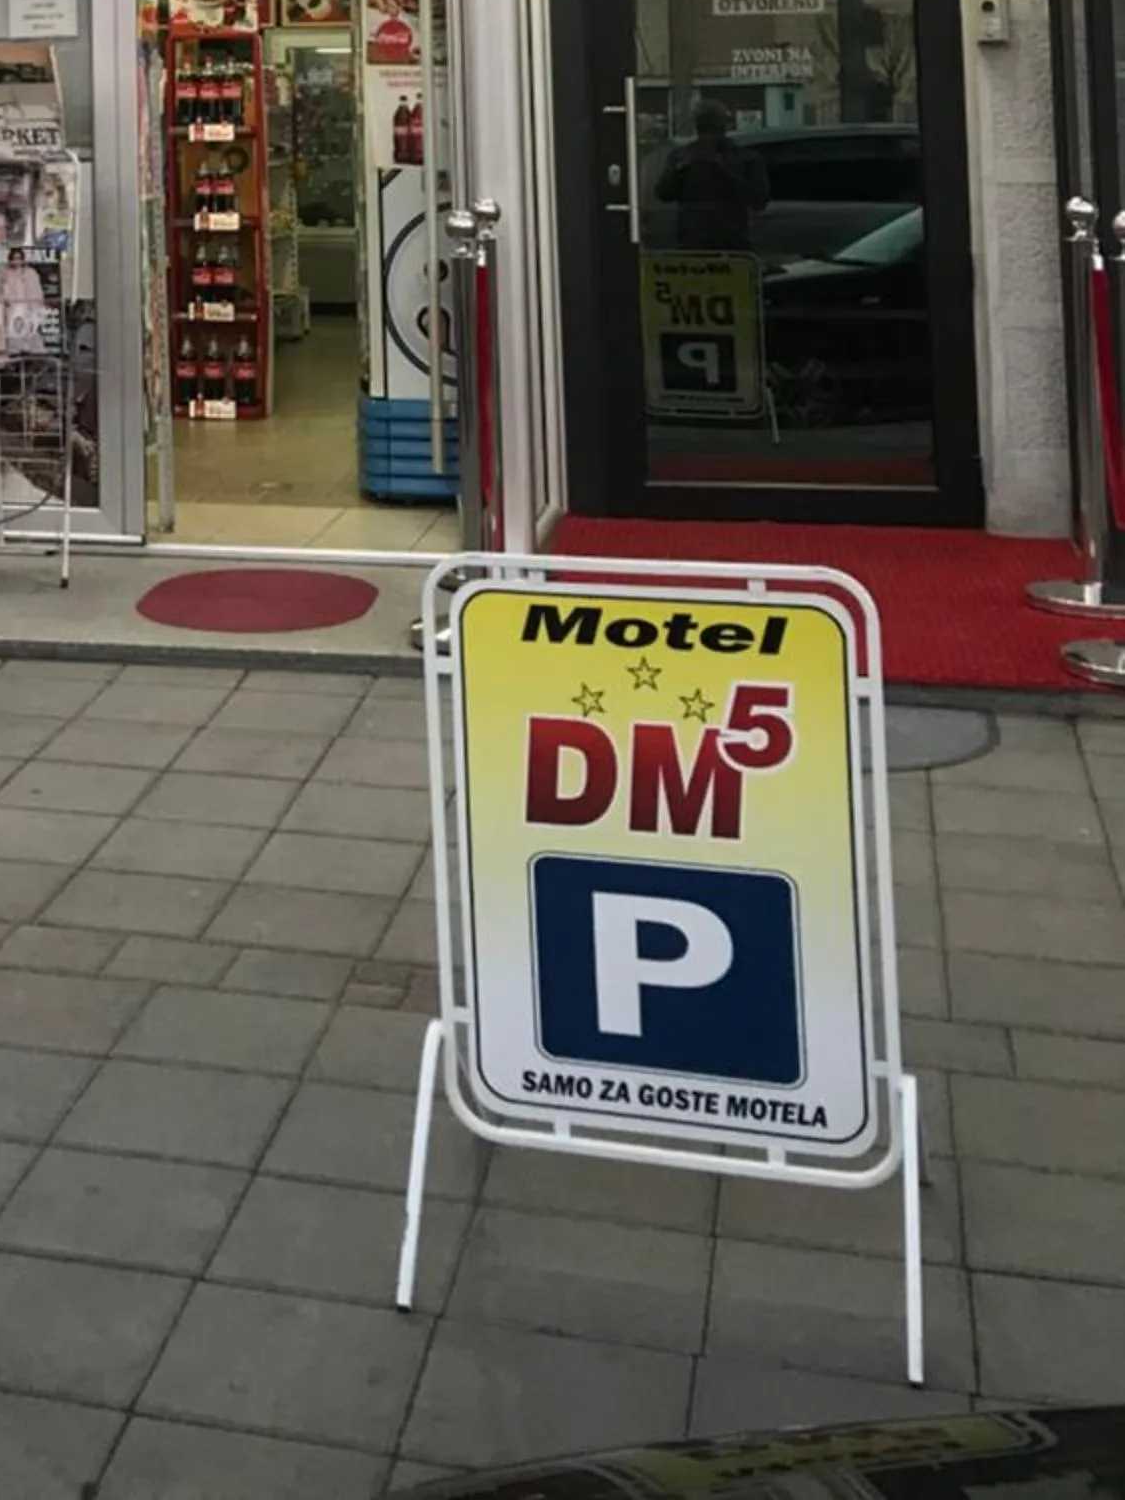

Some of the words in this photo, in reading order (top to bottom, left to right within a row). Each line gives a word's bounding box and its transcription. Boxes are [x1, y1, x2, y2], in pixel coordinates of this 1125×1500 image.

[521, 603, 790, 656] Motel
[525, 681, 795, 841] DM5
[591, 890, 735, 1038] P
[522, 1070, 594, 1100] SAMO
[599, 1081, 631, 1104] ZA
[638, 1083, 720, 1115] GOSTE
[726, 1095, 829, 1129] MOTELA
